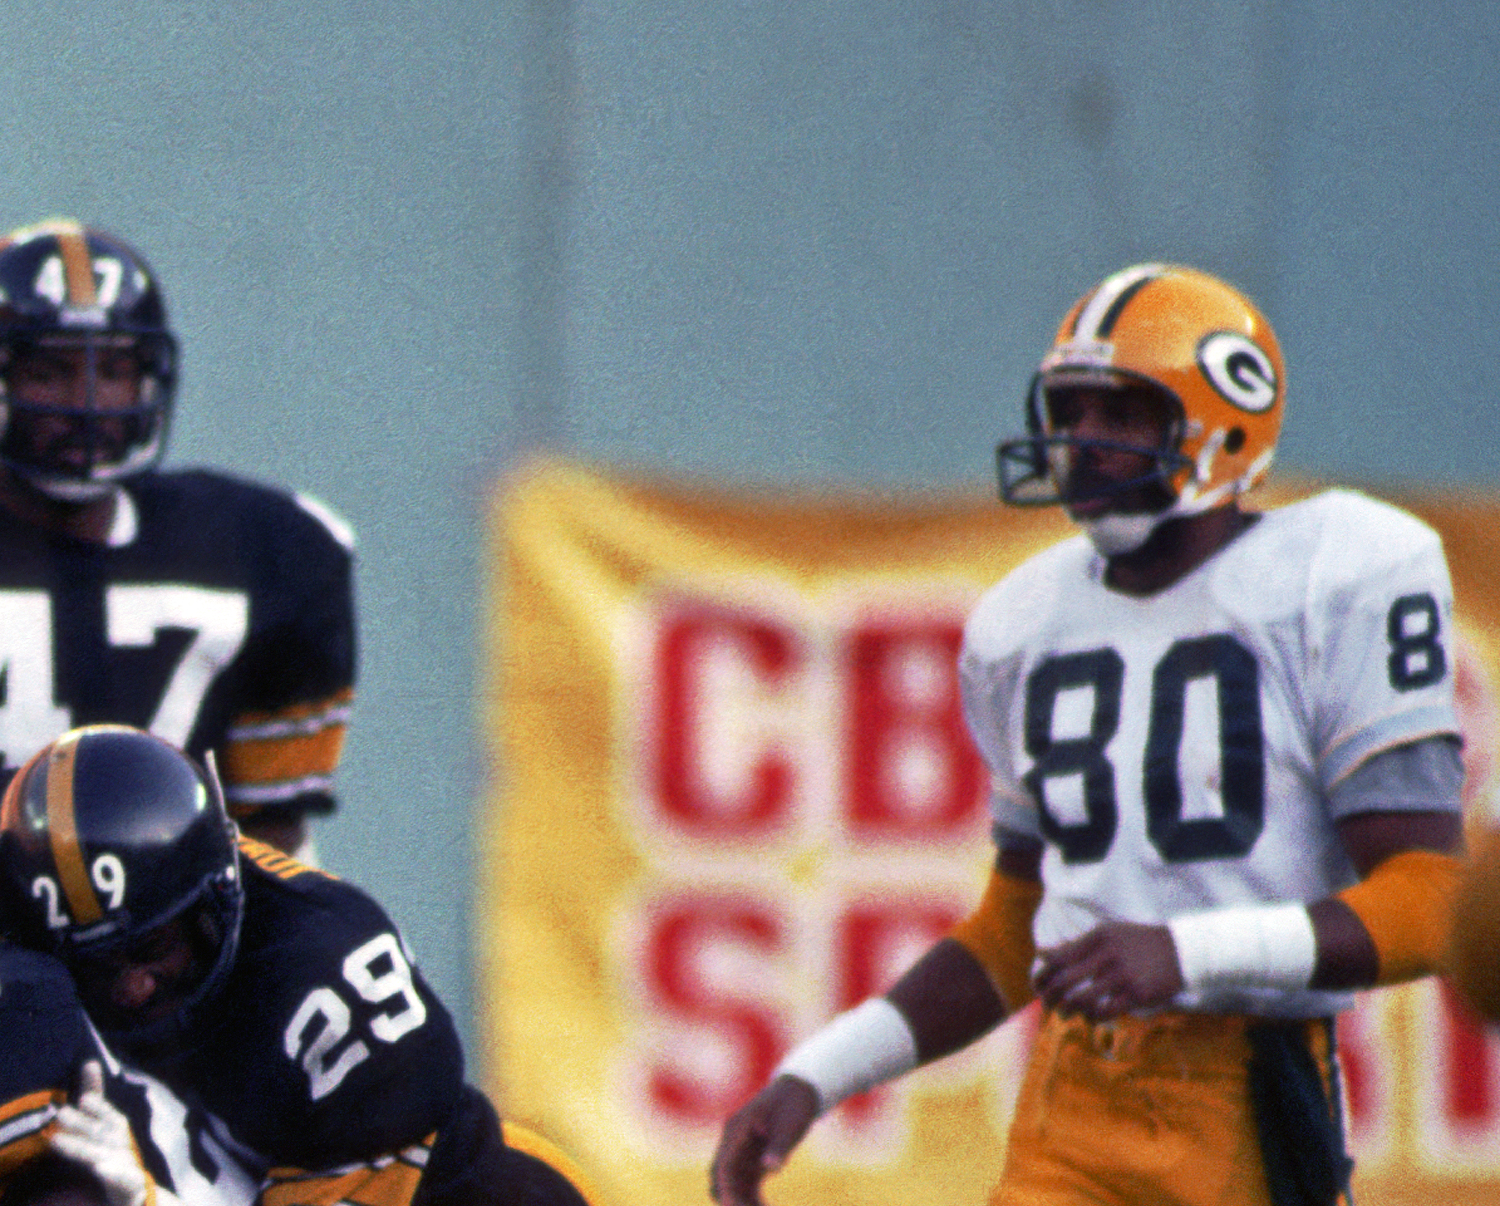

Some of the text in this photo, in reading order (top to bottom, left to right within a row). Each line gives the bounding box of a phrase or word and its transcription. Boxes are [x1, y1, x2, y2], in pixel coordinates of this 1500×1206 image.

[1198, 332, 1277, 413] G
[652, 598, 994, 840] CB
[1022, 634, 1266, 865] 80
[31, 855, 126, 929] 29
[285, 934, 427, 1100] 29
